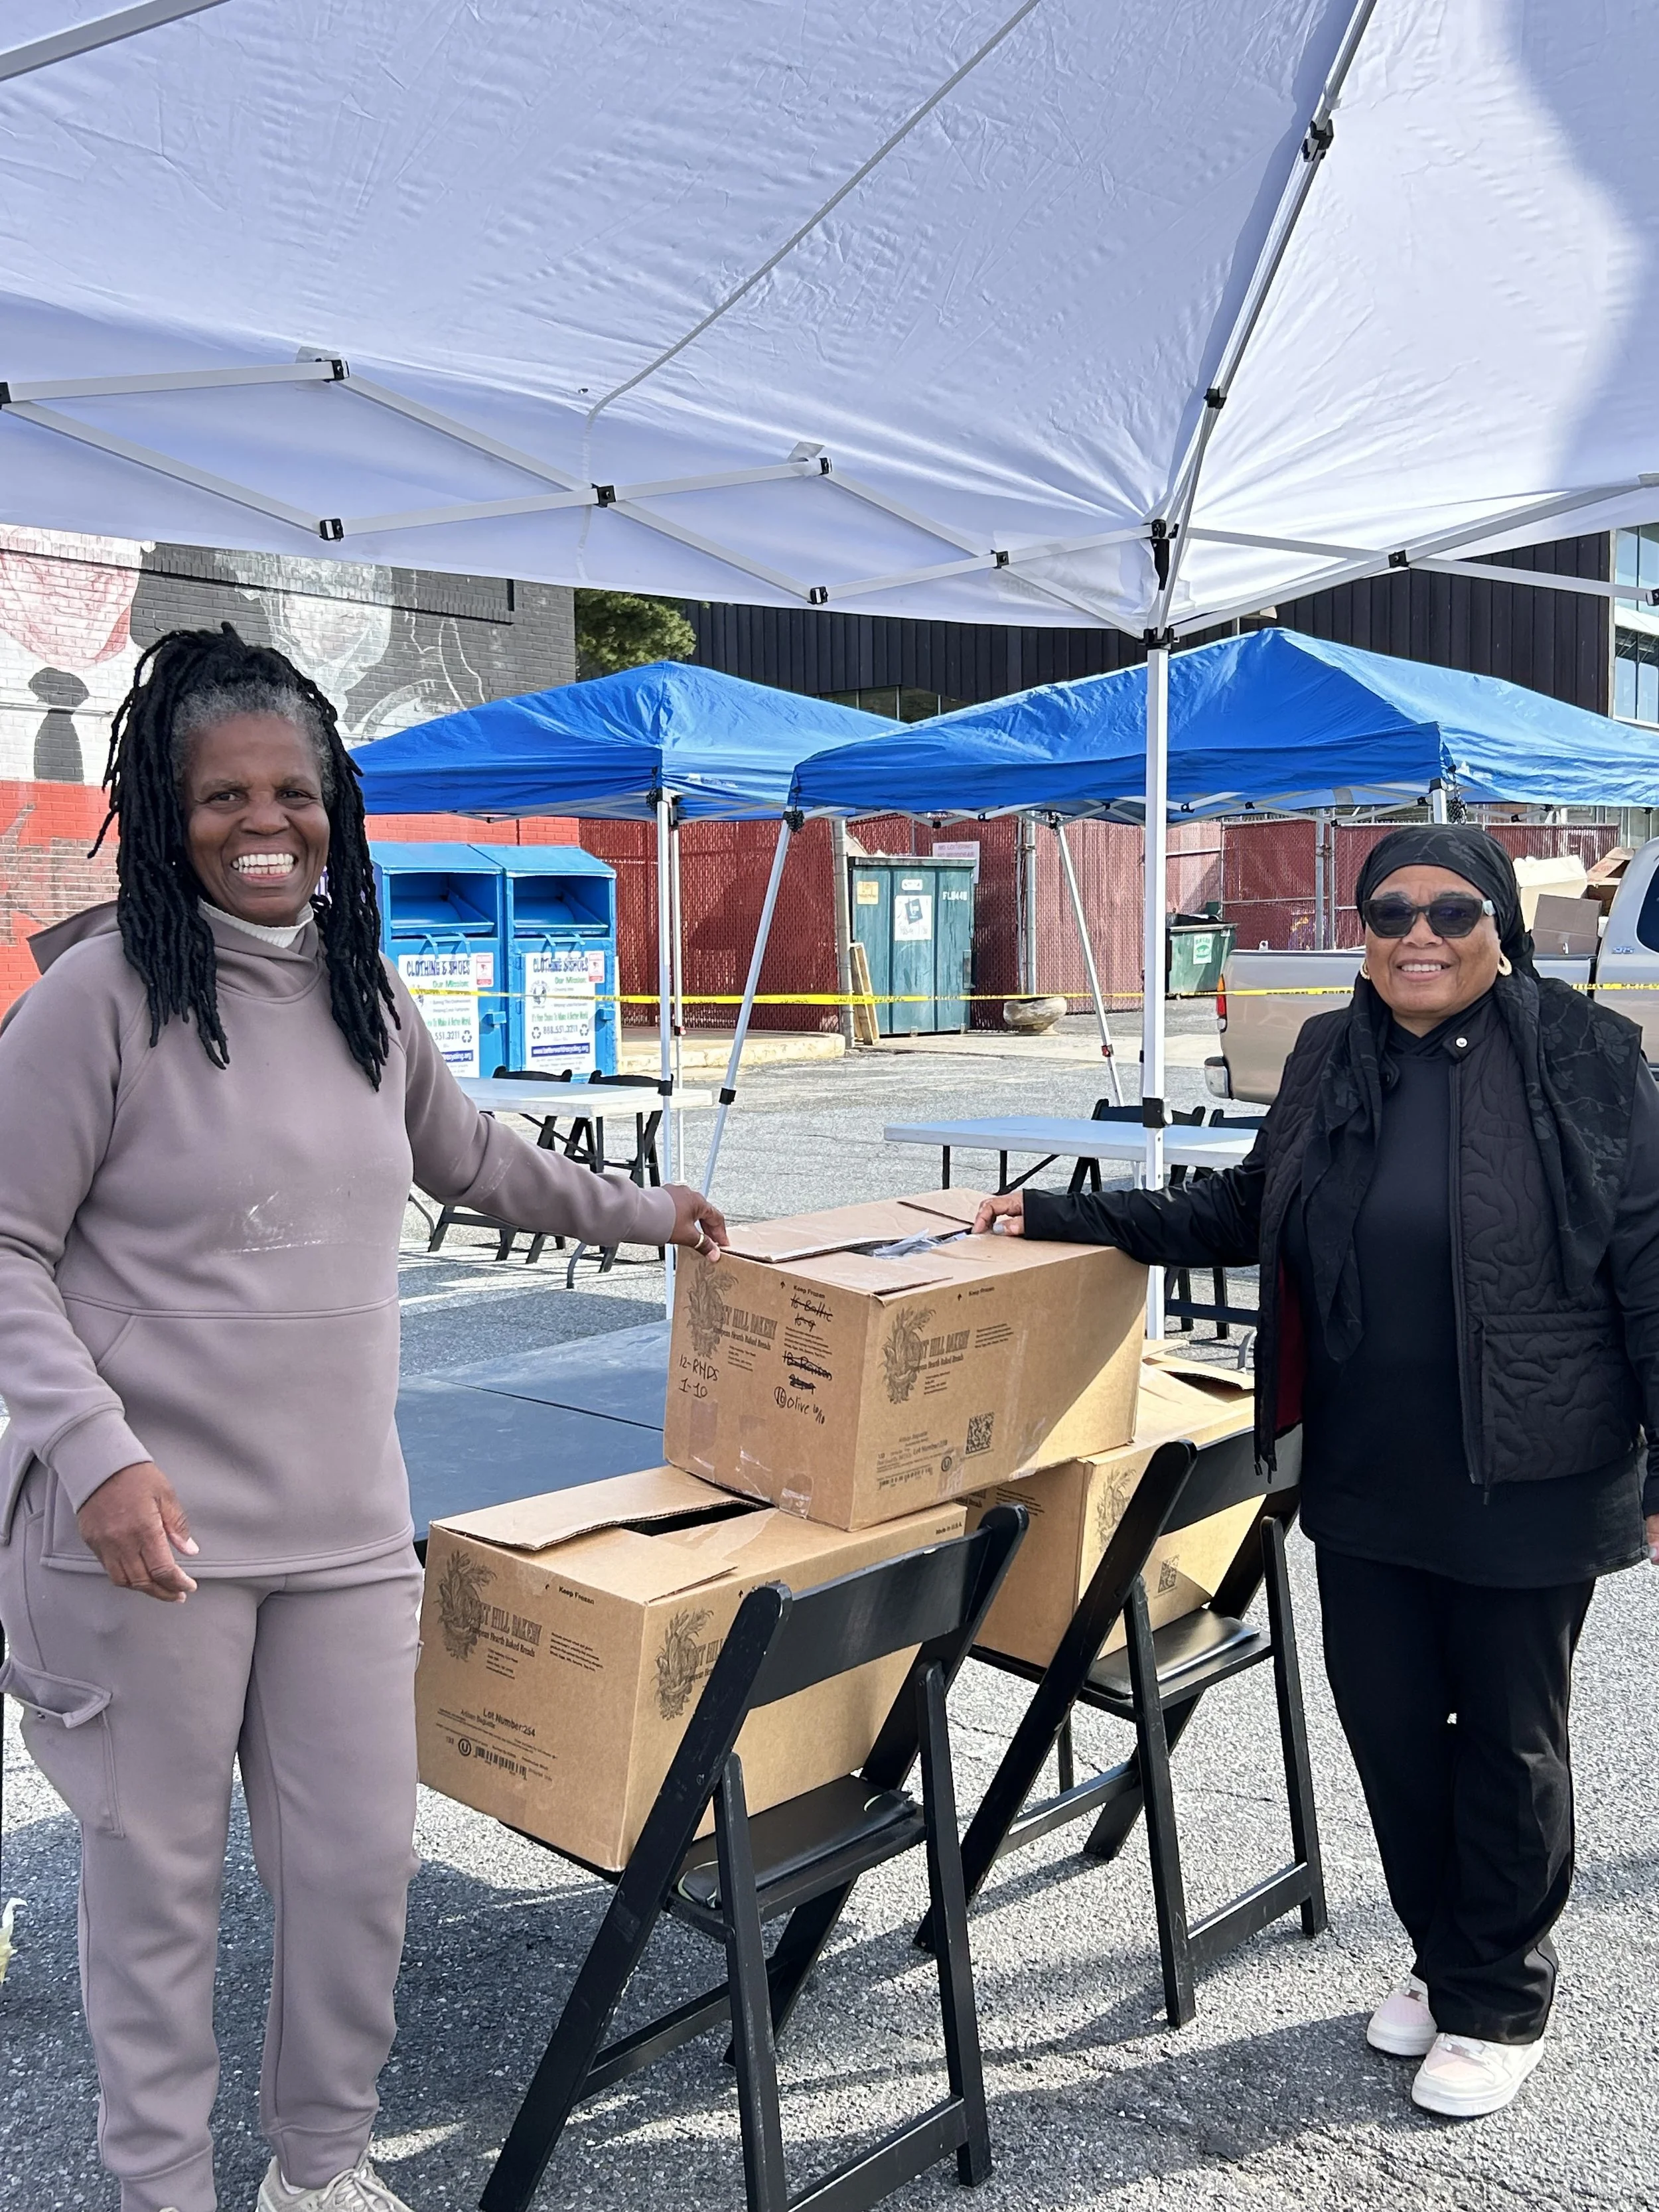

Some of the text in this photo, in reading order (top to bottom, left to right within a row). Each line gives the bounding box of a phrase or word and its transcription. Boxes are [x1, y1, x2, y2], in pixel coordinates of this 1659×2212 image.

[407, 960, 440, 977] CLOTHING
[449, 960, 470, 975] SHOES
[794, 1286, 826, 1298] Keep Frozen
[559, 1585, 595, 1605] Keep Frozen
[483, 1708, 494, 1720] Lot
